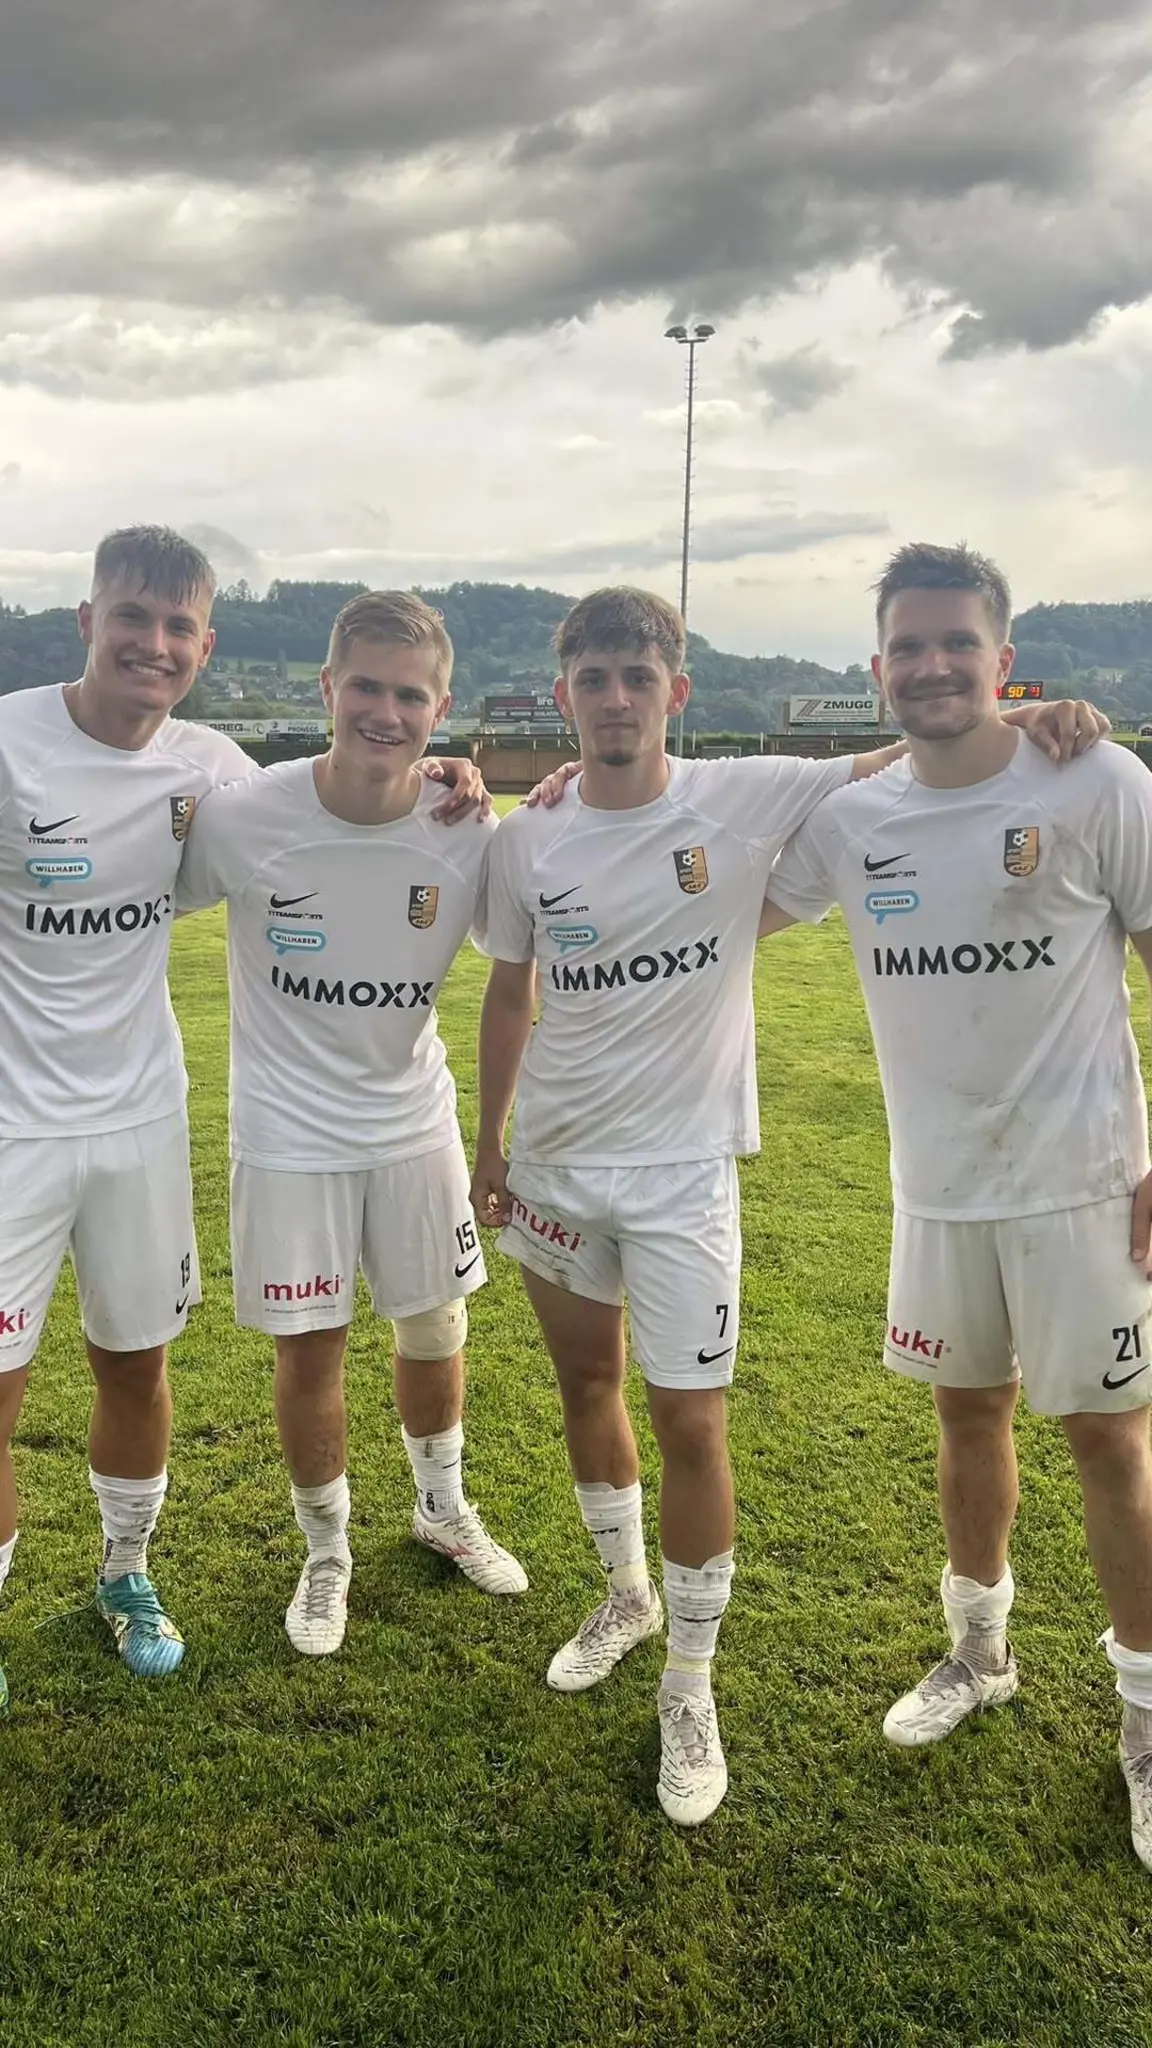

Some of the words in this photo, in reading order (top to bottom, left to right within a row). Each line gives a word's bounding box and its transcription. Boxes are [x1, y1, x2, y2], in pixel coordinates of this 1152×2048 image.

[823, 700, 873, 709] ZMUGG
[35, 865, 84, 873] WILLHABEN
[872, 897, 911, 907] WILLHABEN
[275, 932, 318, 945] WILLHABEN
[873, 935, 1056, 976] IMMOXX
[552, 936, 719, 991] IMMOXX
[271, 964, 434, 1008] IMMOXX
[456, 1220, 476, 1255] 15
[264, 1274, 340, 1301] muki
[716, 1303, 729, 1338] 7
[1112, 1323, 1141, 1362] 21
